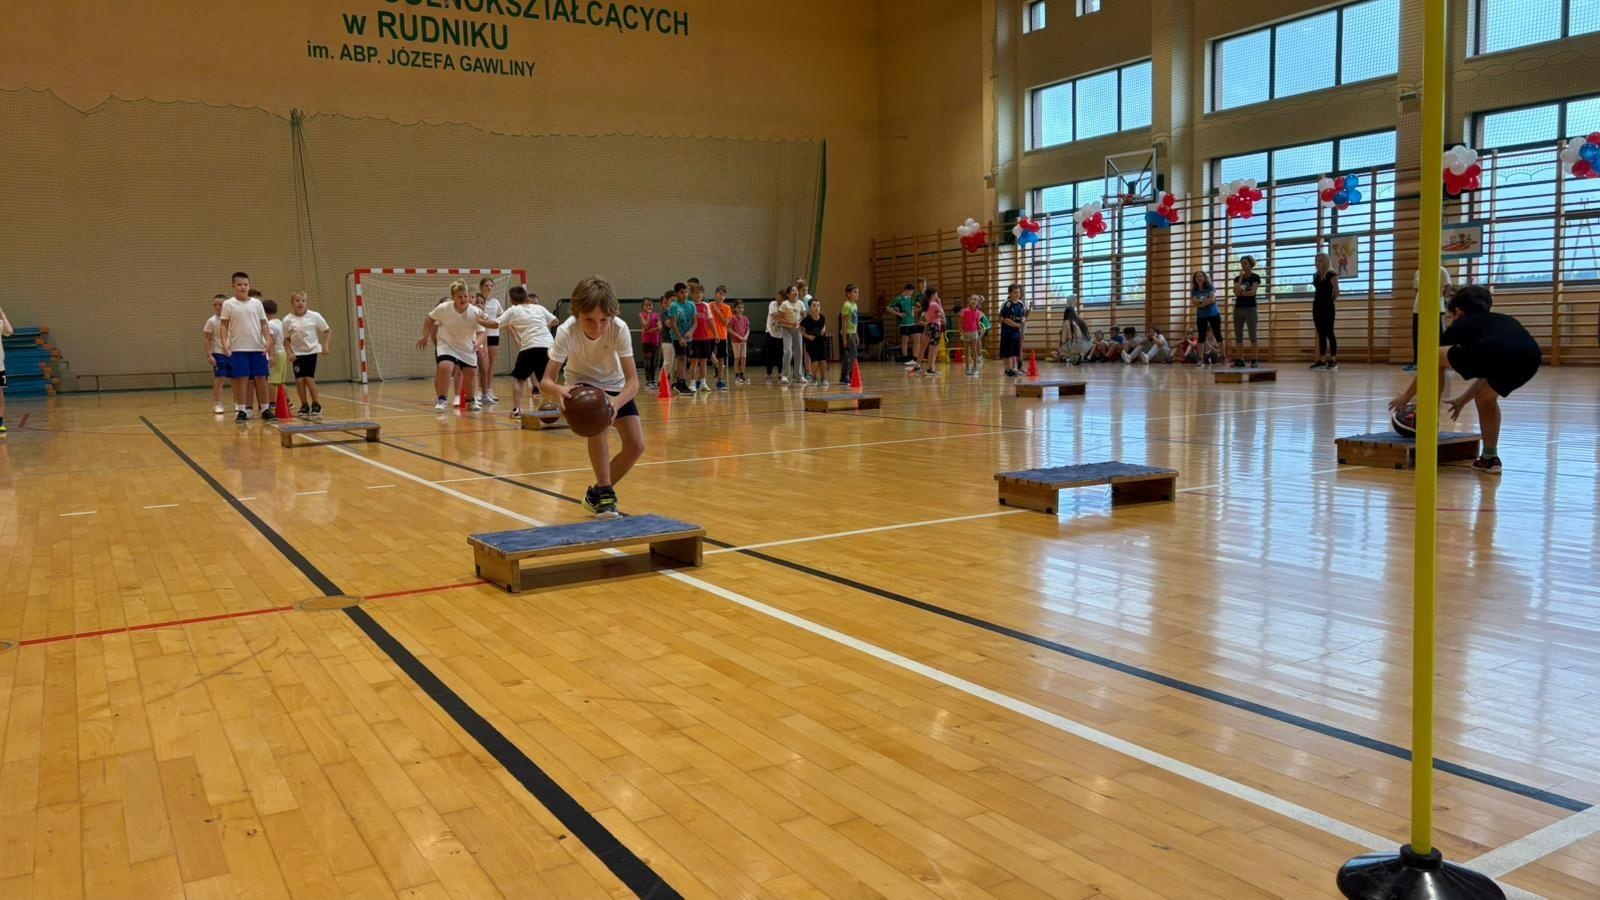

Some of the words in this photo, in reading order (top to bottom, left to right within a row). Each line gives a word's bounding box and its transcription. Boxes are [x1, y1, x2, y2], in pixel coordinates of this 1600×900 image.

[377, 10, 509, 51] RUDNIKU
[385, 0, 689, 37] KSZTAŁCĄCYCH
[307, 40, 335, 60] im.
[339, 43, 382, 64] ABP.
[386, 46, 456, 71] JÓZEFA
[459, 55, 536, 77] GAWLINY
